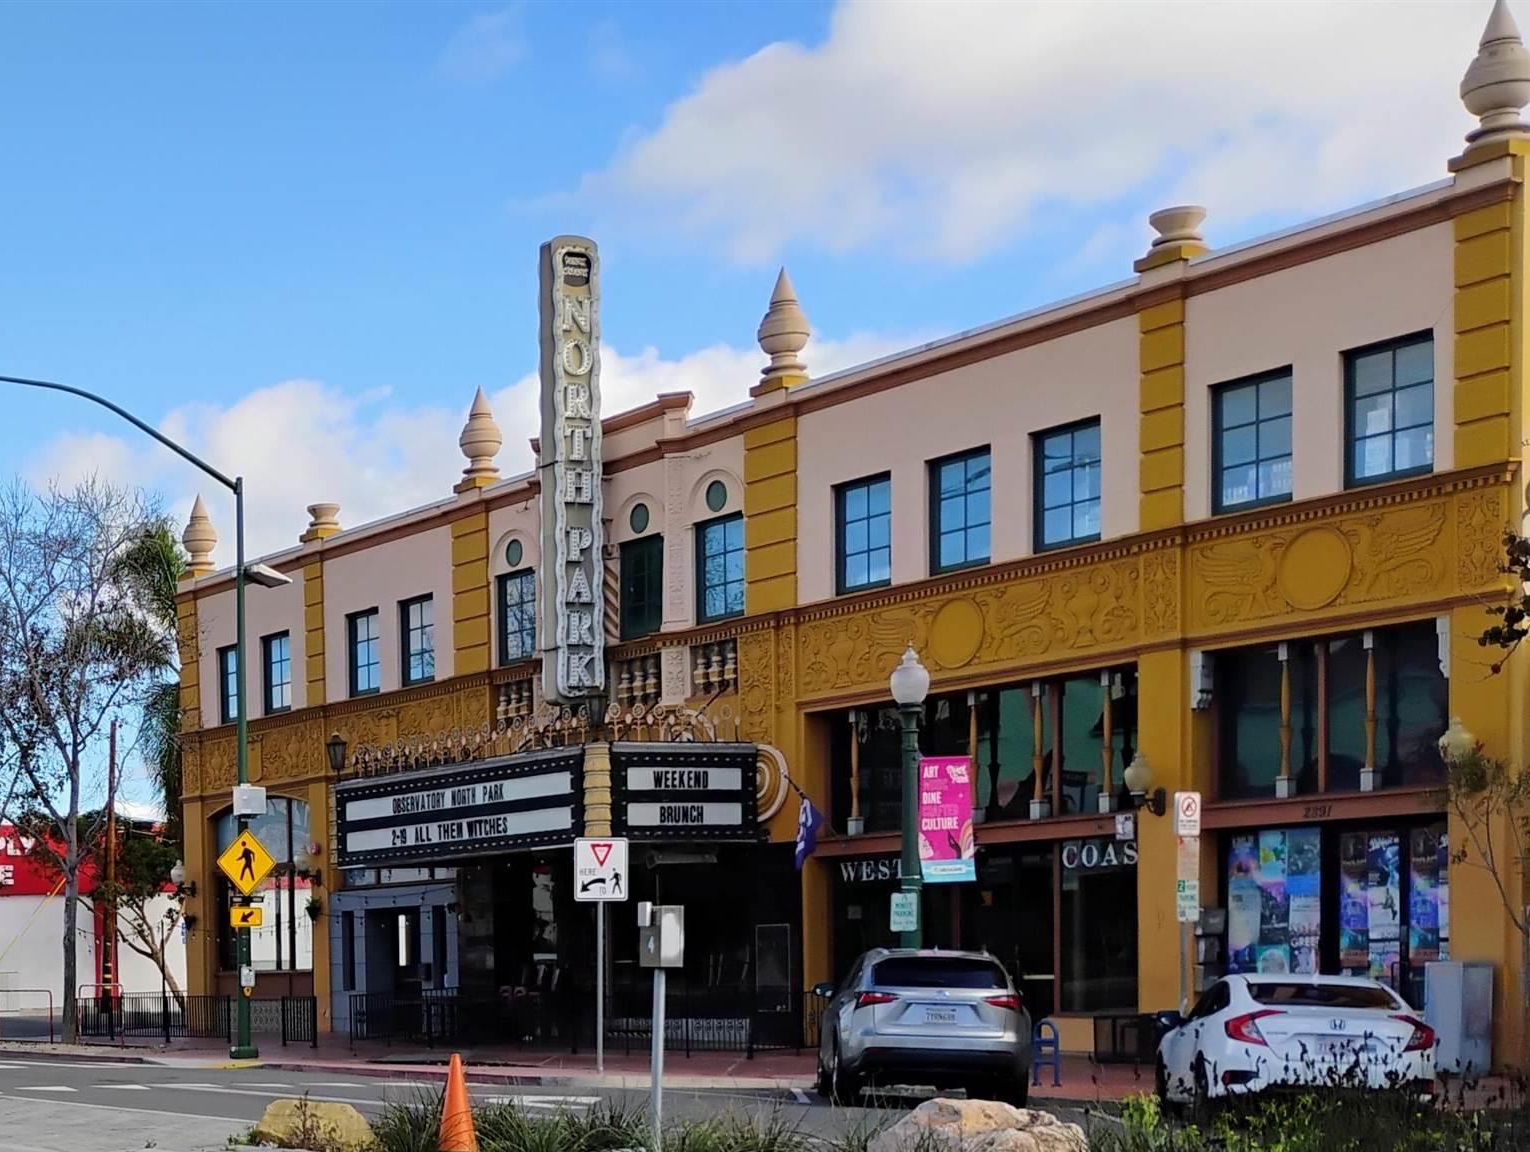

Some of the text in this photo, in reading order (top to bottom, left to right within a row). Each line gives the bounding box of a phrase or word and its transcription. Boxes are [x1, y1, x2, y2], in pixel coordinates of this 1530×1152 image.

[562, 295, 597, 687] NORTH PARK
[653, 770, 709, 789] WEEKEND
[923, 765, 939, 779] ART
[392, 783, 504, 815] OBSERVATORY NORTH PARK
[922, 791, 942, 805] DINE
[659, 805, 704, 824] BRUNCH
[921, 816, 959, 831] CULTURE
[392, 816, 508, 846] 2-19 ALL THEM WITCHES
[839, 841, 1139, 883] WEST COAS
[579, 868, 597, 876] HERE
